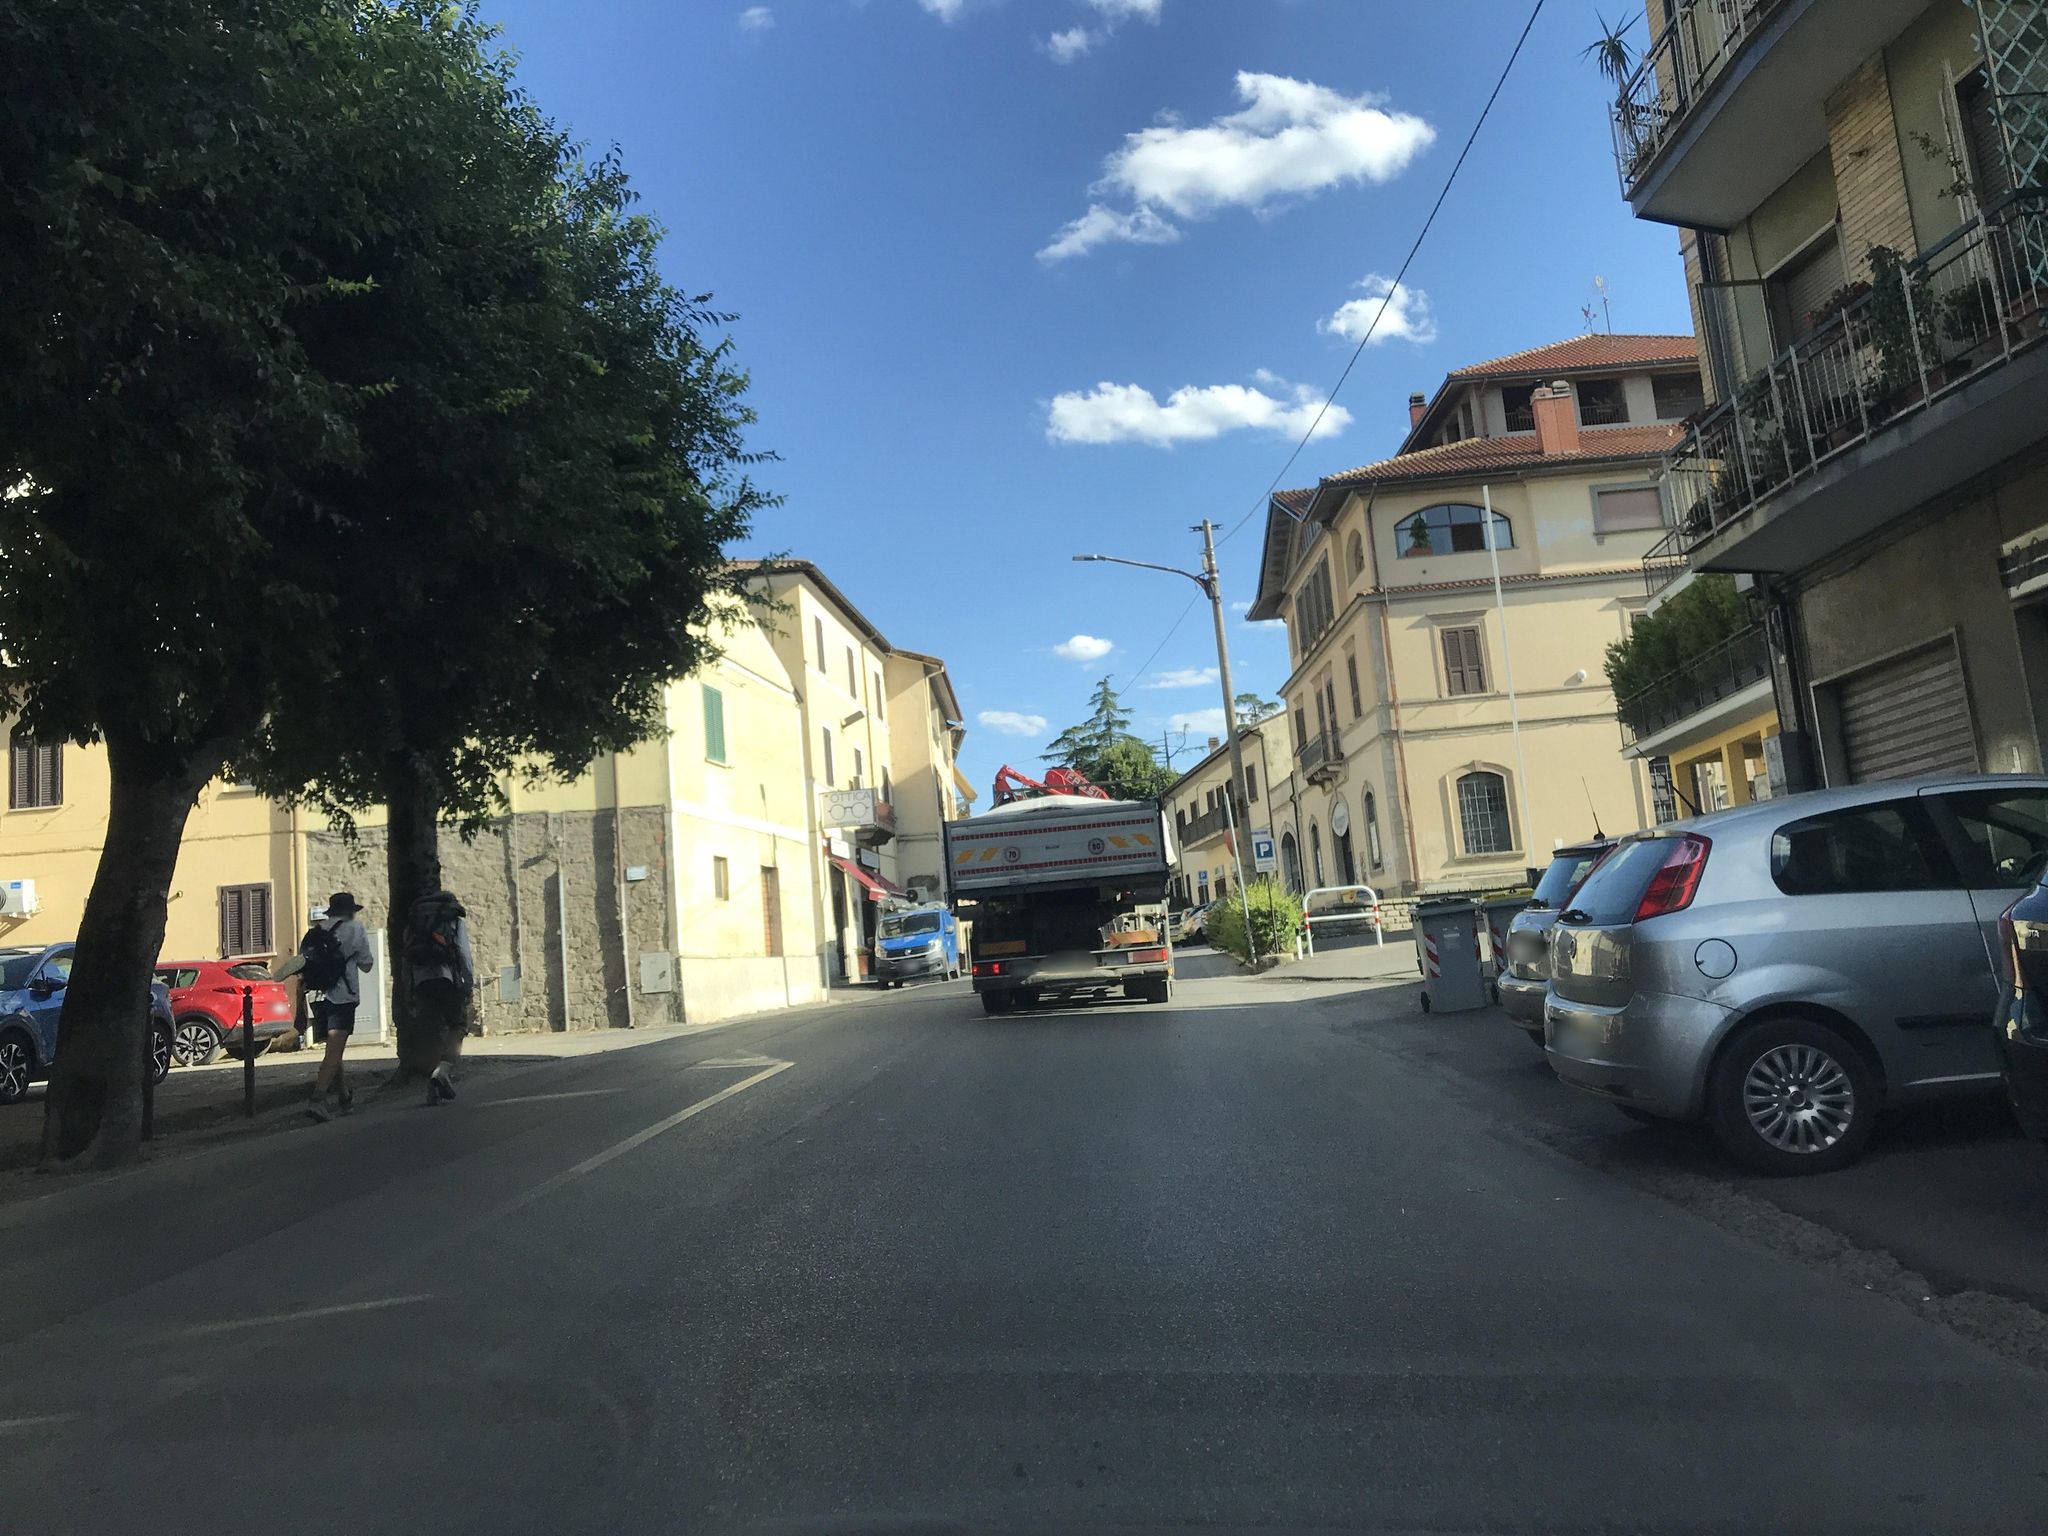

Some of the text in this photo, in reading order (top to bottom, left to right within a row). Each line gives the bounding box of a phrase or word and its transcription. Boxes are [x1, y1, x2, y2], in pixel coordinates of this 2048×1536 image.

[830, 791, 872, 803] OTTICA
[1008, 850, 1017, 859] 70
[1260, 843, 1270, 857] P
